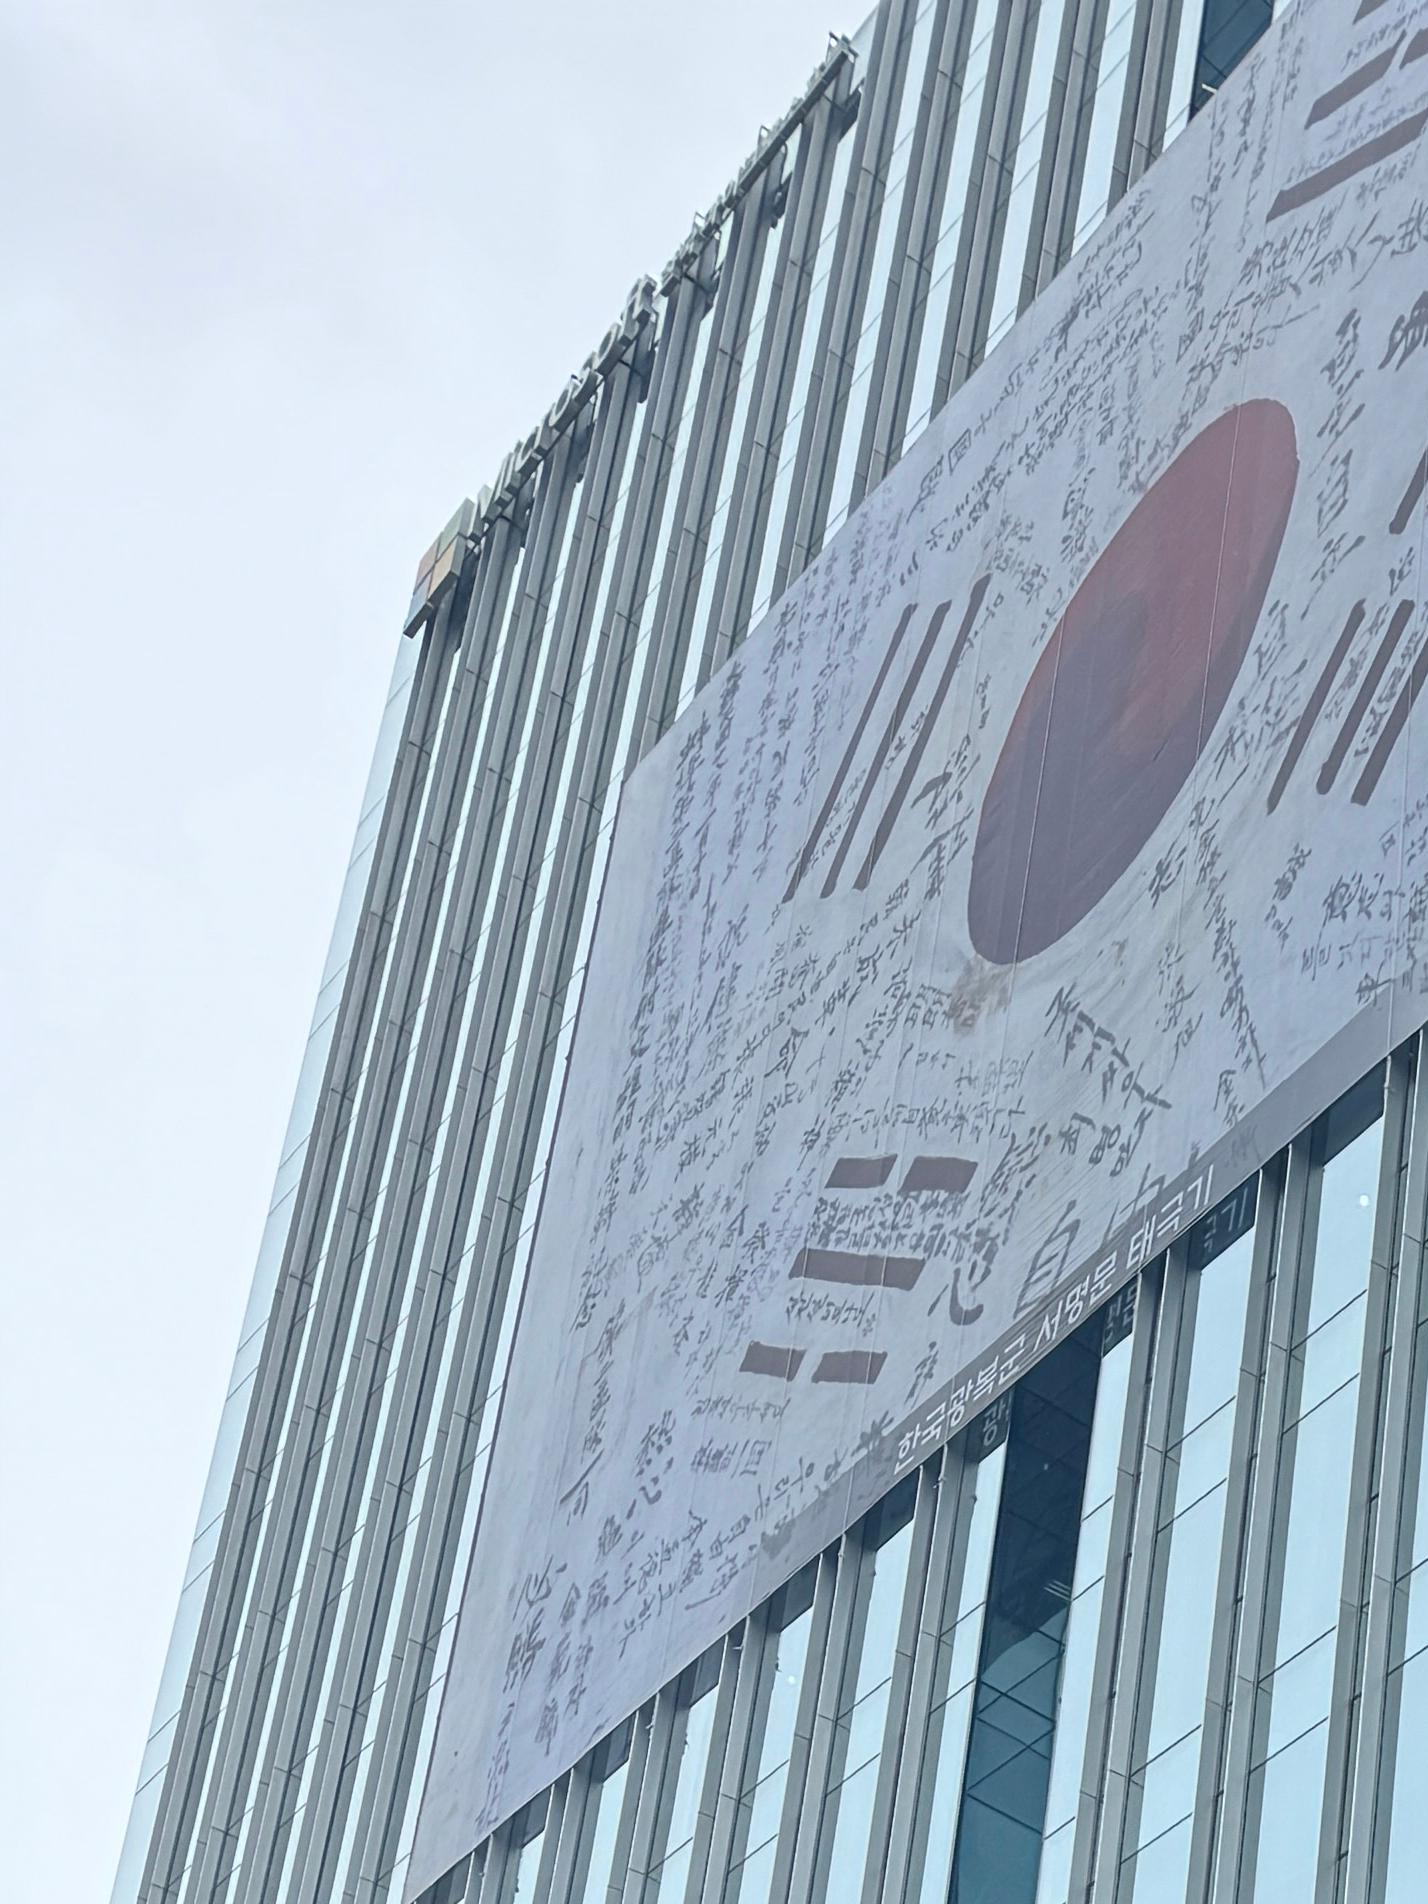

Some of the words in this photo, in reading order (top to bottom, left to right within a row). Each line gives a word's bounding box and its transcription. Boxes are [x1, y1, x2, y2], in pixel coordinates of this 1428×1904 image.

[894, 1336, 1026, 1475] 한국광복군
[1033, 1250, 1116, 1353] 서명문
[1126, 1164, 1214, 1268] 태극기
